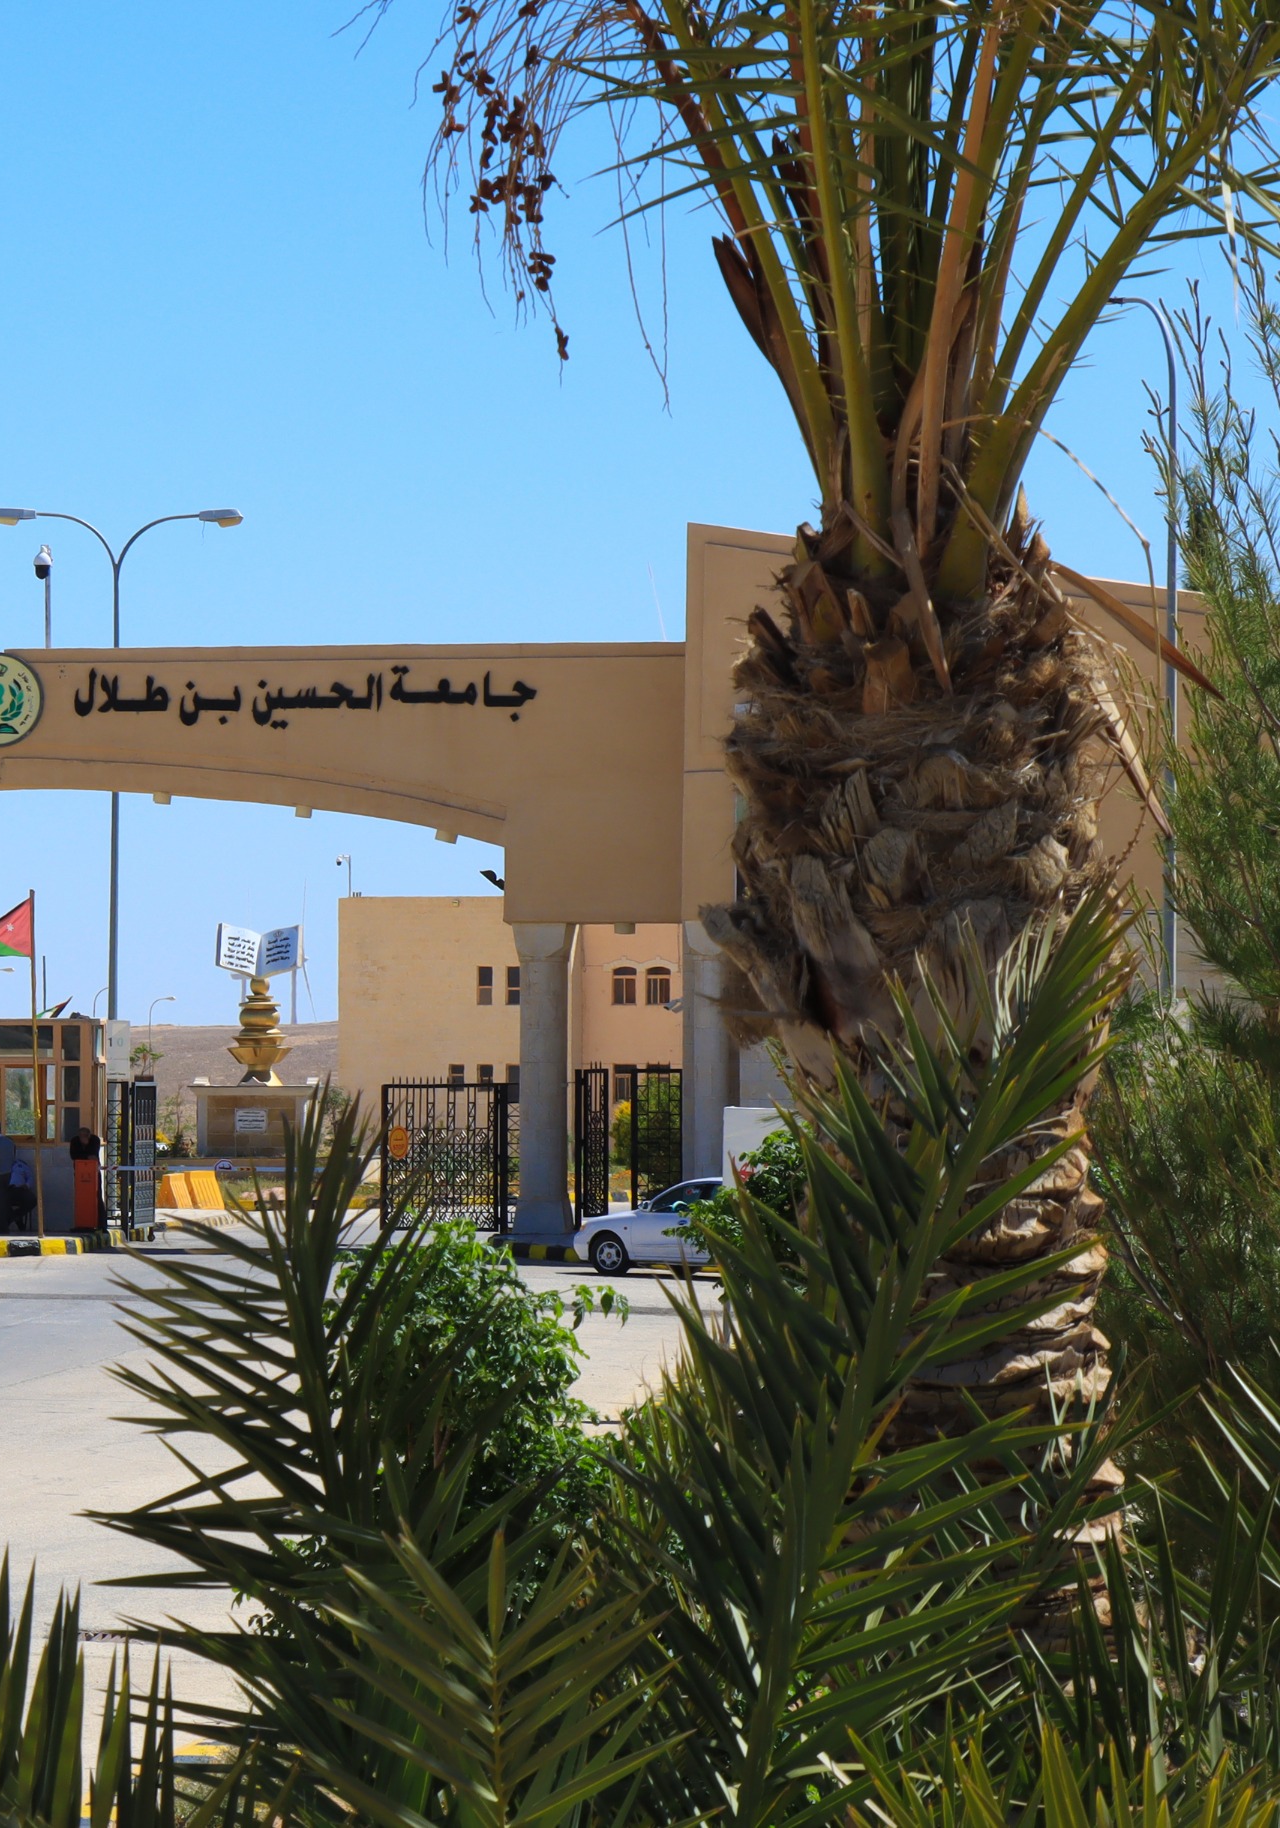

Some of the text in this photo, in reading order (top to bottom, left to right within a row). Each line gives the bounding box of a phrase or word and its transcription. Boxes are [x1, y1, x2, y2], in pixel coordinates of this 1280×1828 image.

[74, 667, 169, 717] طلال
[179, 680, 241, 726] بن
[252, 672, 382, 730] الحسين
[390, 665, 537, 722] جامعة
